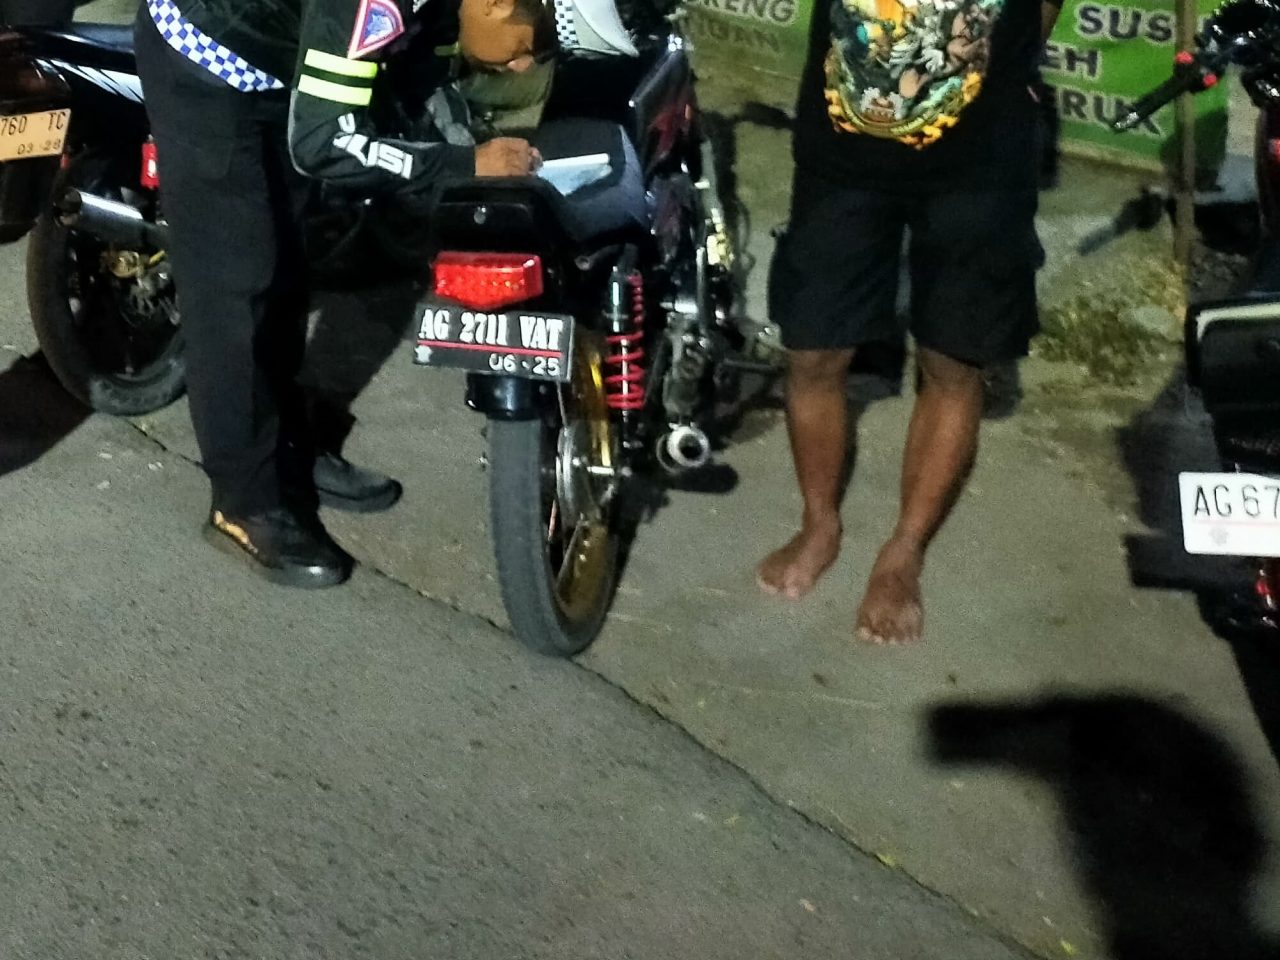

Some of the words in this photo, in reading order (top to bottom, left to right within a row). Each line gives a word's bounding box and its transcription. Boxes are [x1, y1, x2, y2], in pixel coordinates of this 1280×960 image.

[1078, 5, 1212, 43] SUS
[1043, 43, 1099, 78] EH
[48, 111, 66, 131] TC
[1061, 90, 1160, 135] RUK
[418, 309, 450, 340] AG
[459, 311, 508, 346] 2711
[519, 315, 564, 350] VAT
[1194, 484, 1232, 517] AG
[1241, 484, 1280, 519] 67
